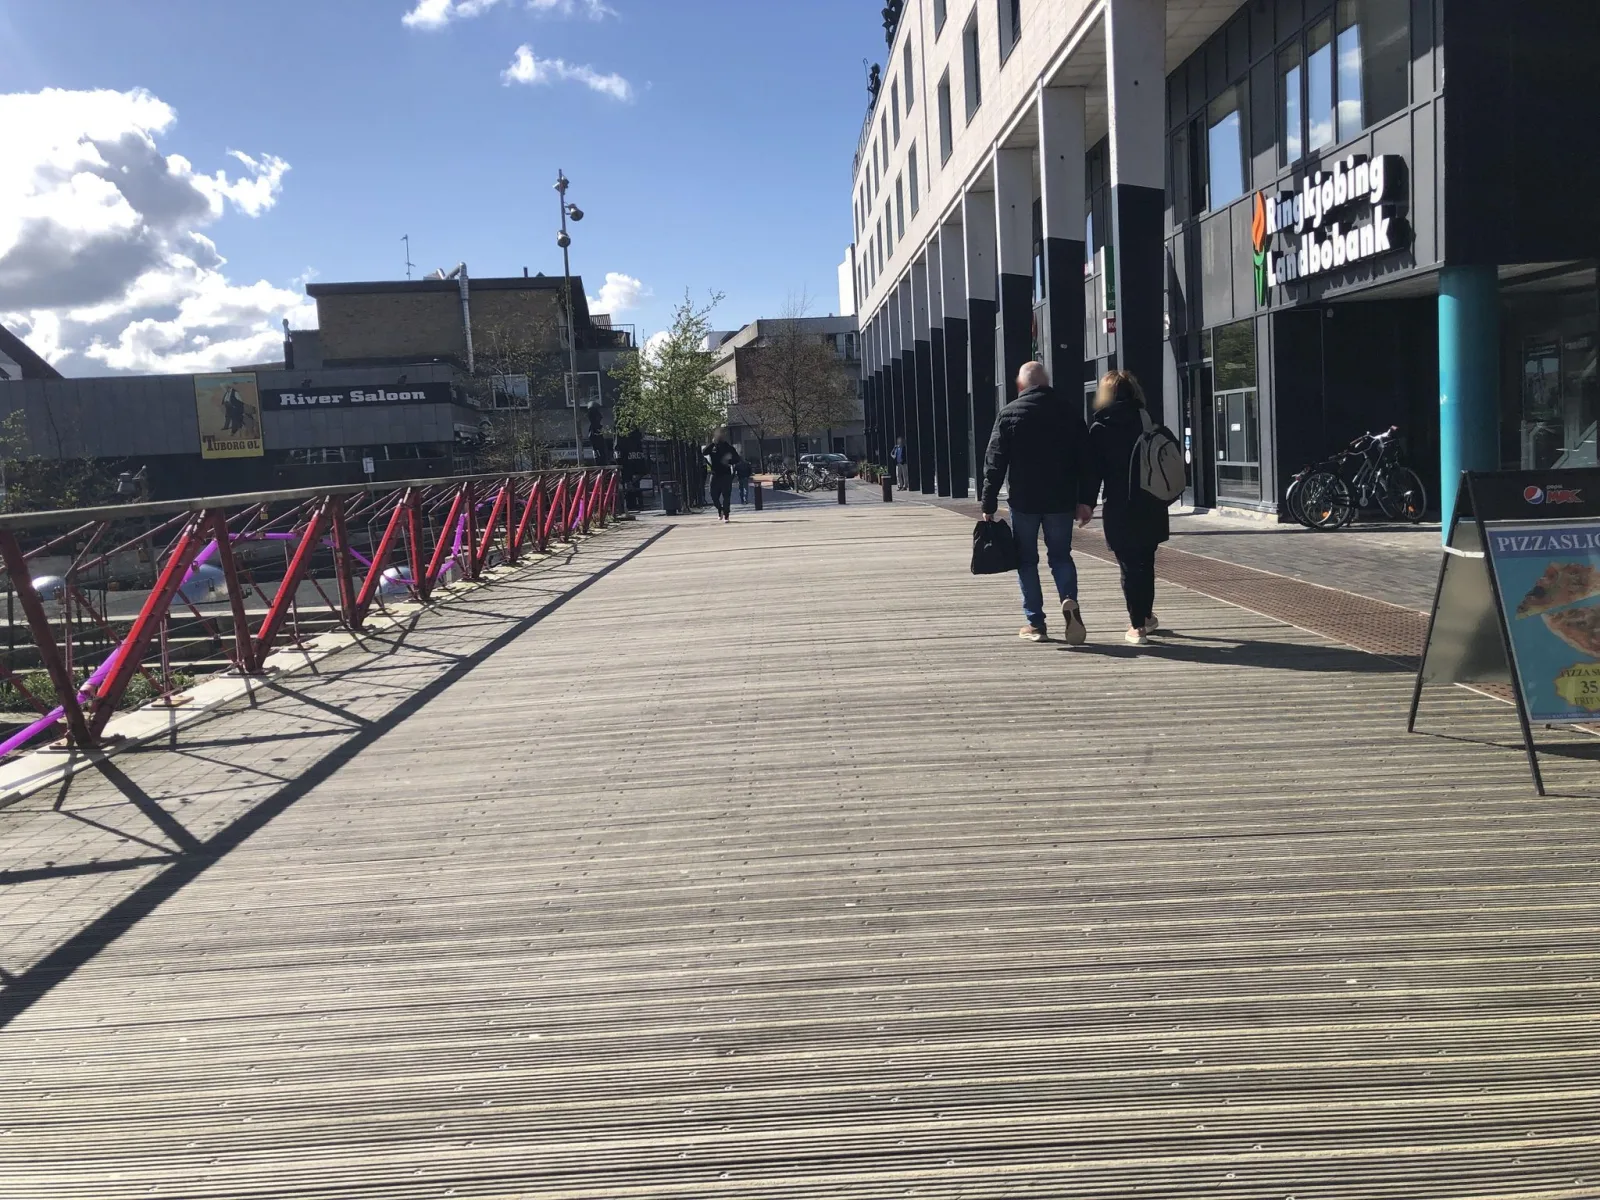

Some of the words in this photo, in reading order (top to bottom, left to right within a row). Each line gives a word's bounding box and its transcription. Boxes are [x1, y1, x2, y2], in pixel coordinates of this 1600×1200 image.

[1265, 154, 1385, 235] Ringkjøbing
[1266, 205, 1391, 287] Landbobank
[279, 393, 344, 406] River
[350, 389, 426, 403] Saloon
[202, 435, 246, 451] TUBORG
[247, 440, 260, 449] ØL
[1580, 680, 1599, 694] 35
